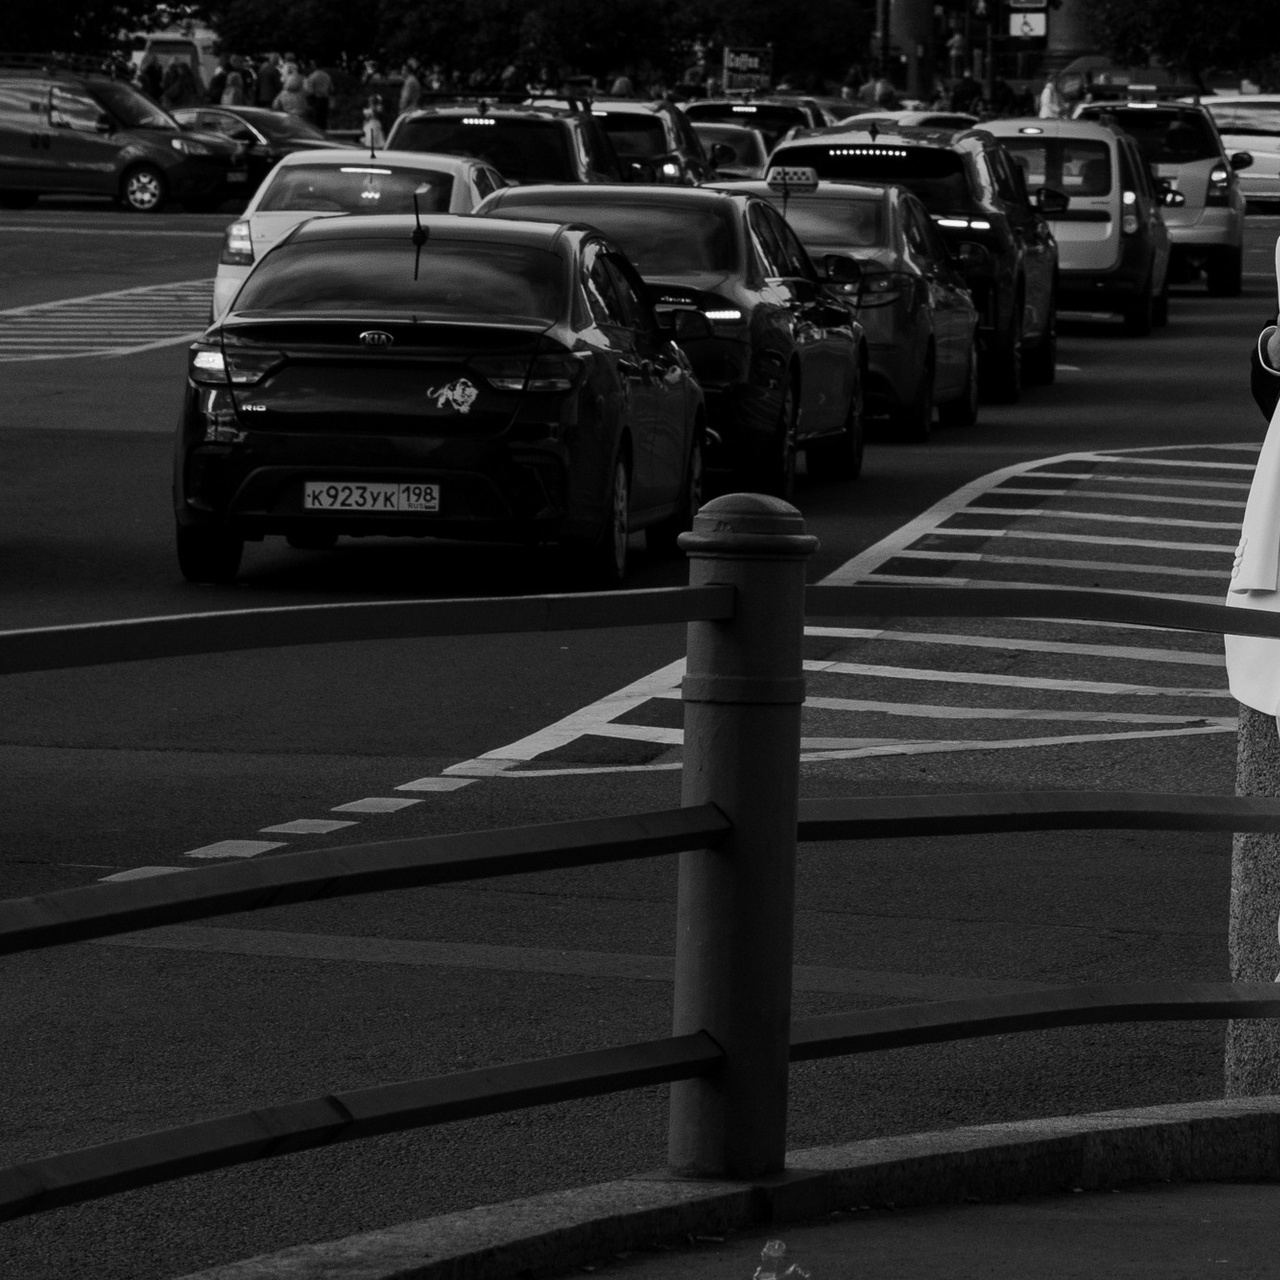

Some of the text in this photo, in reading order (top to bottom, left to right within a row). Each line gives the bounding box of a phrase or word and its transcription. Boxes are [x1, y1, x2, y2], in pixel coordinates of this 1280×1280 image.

[365, 334, 388, 345] KIA
[241, 404, 267, 412] RIO
[401, 486, 434, 503] 198
[407, 502, 424, 510] RUS
